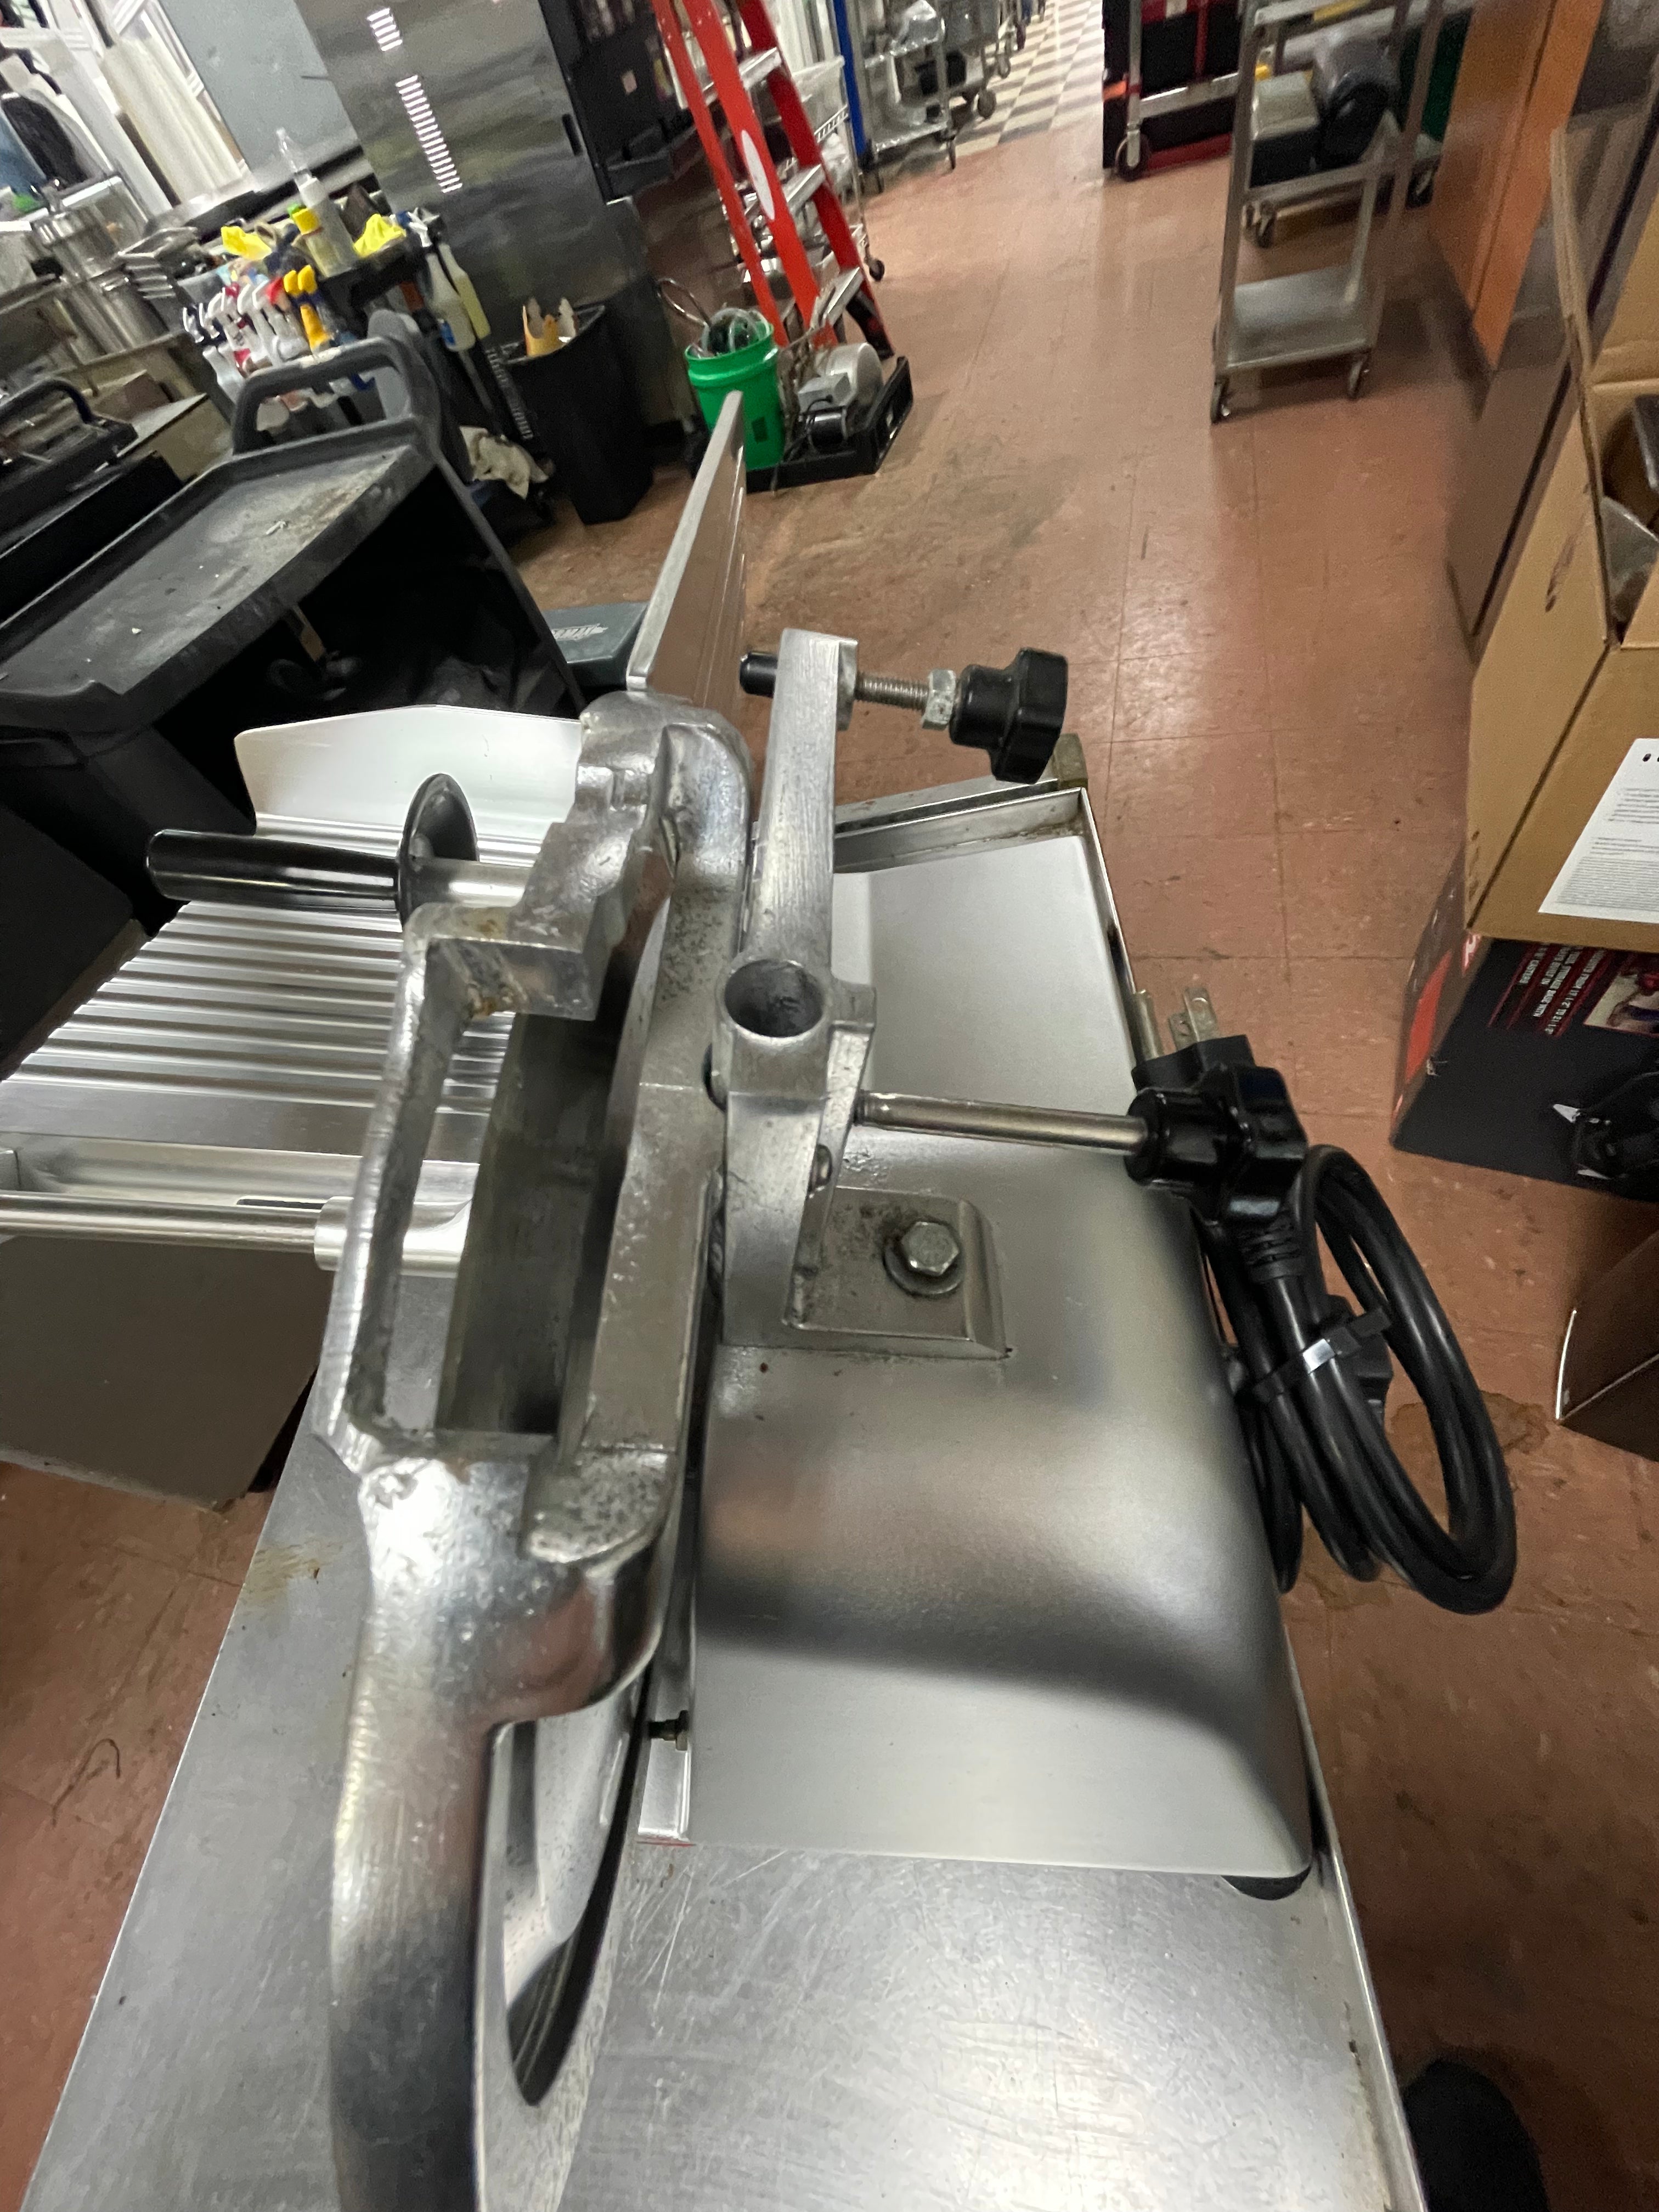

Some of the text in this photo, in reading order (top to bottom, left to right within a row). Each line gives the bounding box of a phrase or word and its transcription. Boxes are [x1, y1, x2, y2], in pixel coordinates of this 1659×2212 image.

[1519, 960, 1539, 984] CASTERS
[1573, 973, 1590, 989] FROM
[1541, 990, 1556, 1004] BASE
[1533, 1003, 1548, 1017] WITH
